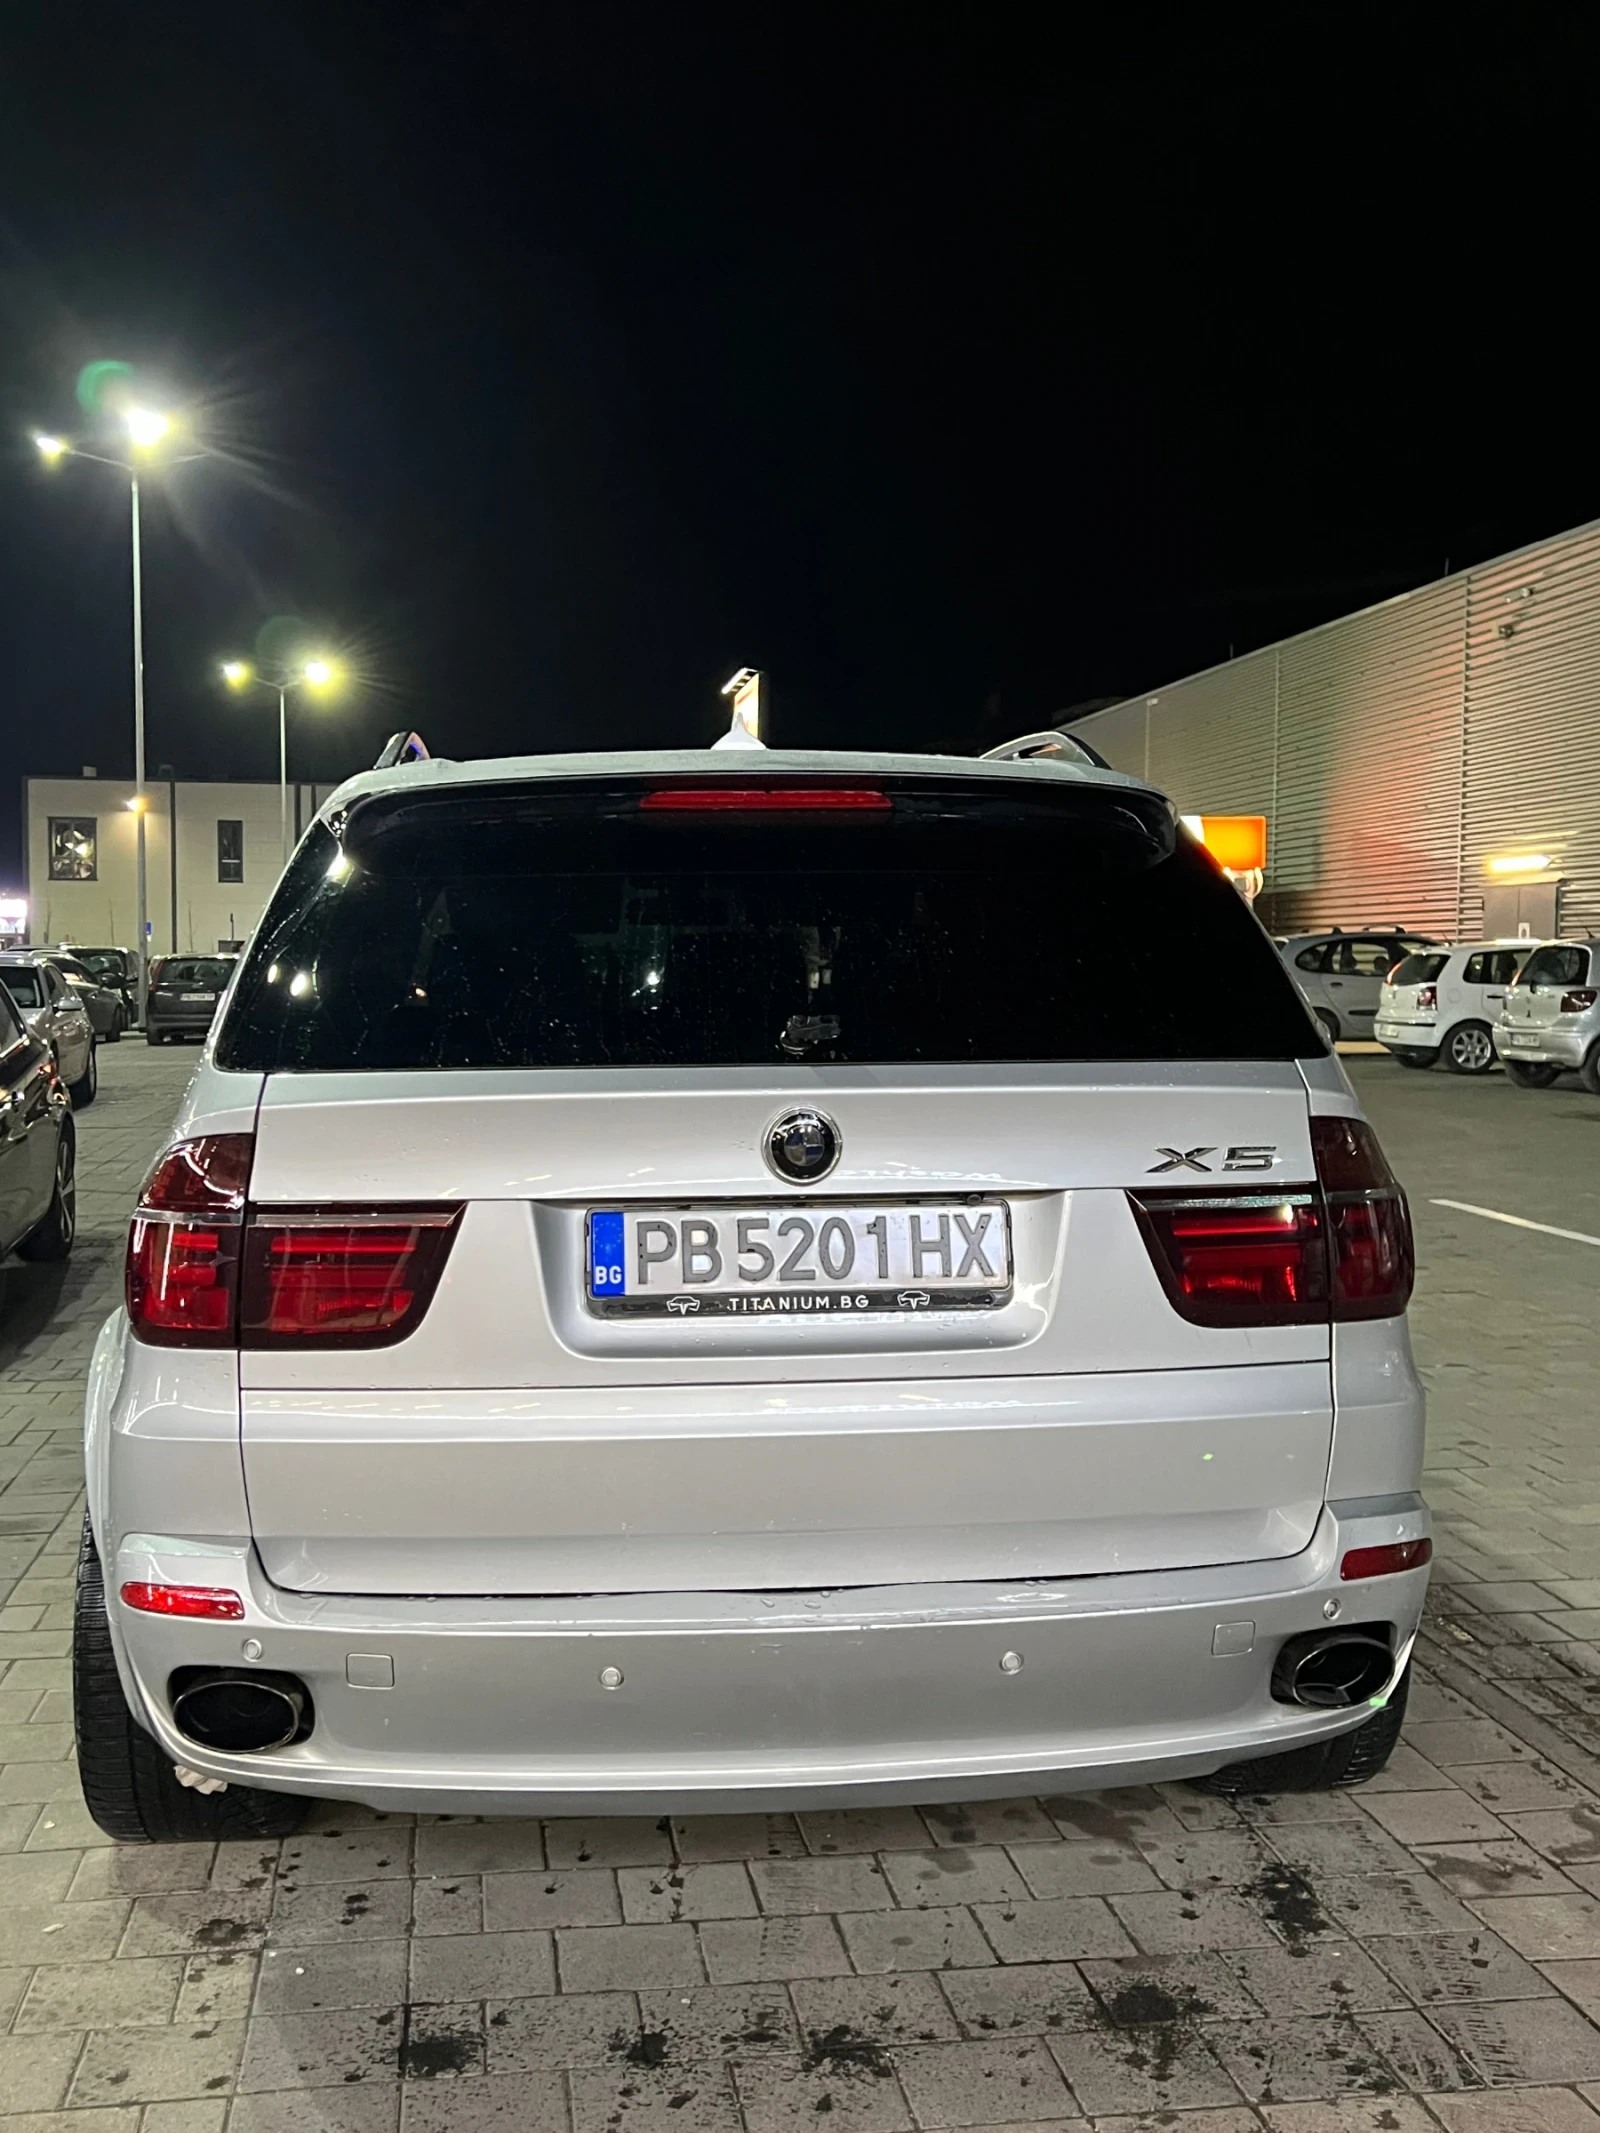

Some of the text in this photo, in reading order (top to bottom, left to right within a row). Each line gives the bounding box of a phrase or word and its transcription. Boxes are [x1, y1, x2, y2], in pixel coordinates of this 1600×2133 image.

[1144, 1146, 1277, 1173] X5
[636, 1213, 995, 1285] PB 5201 HX
[594, 1266, 623, 1285] BG
[728, 1294, 870, 1312] TITANIUM.BG
